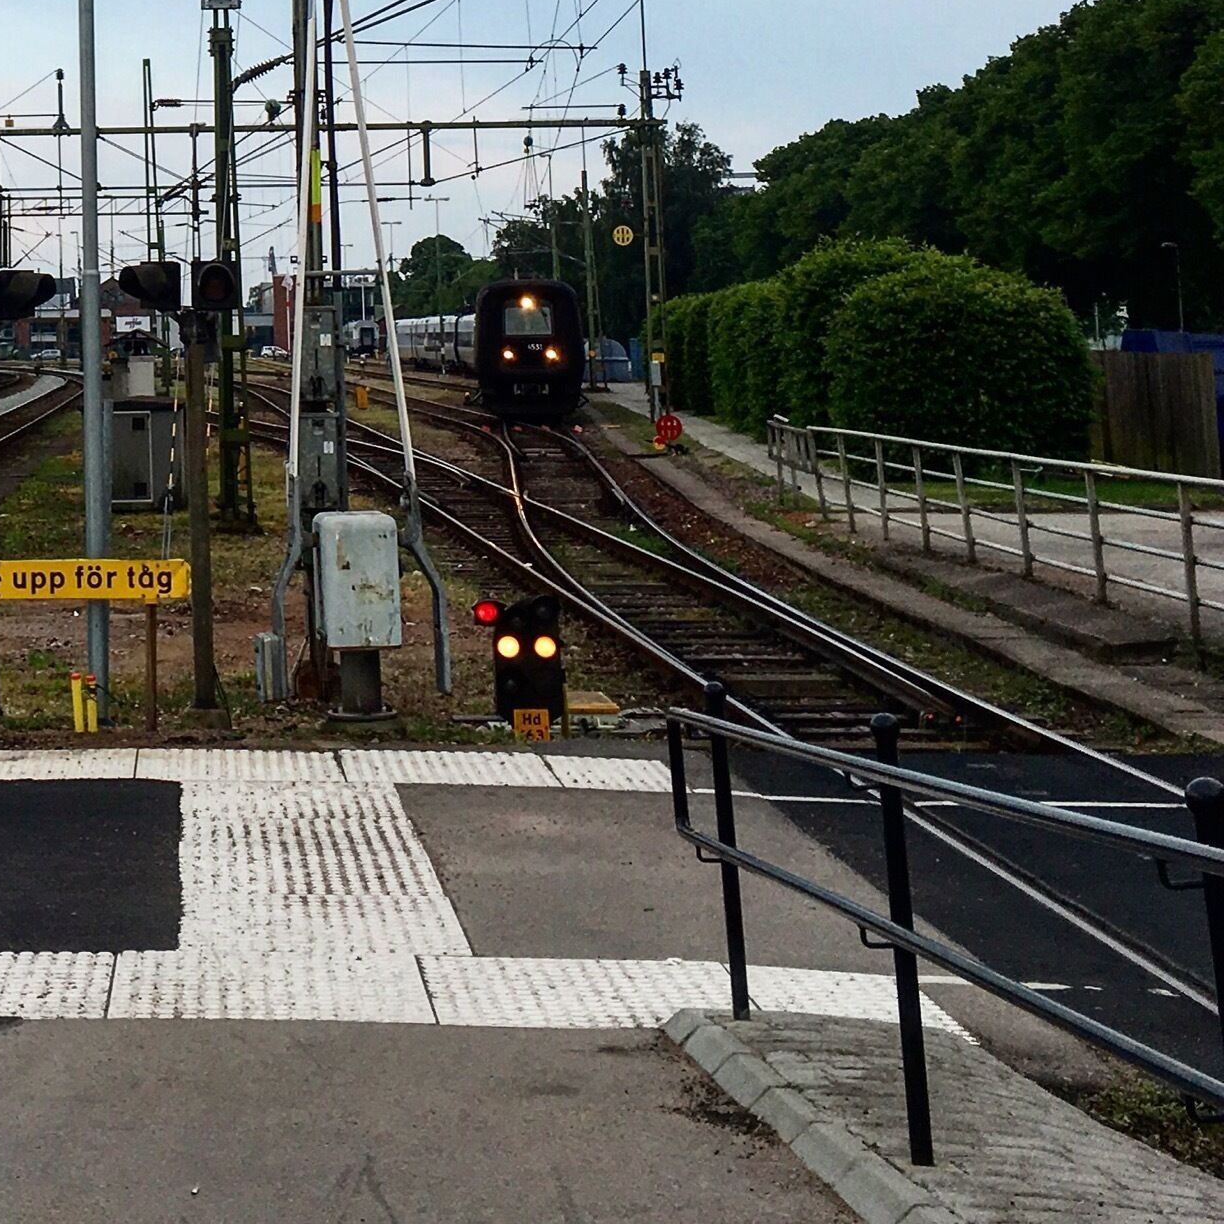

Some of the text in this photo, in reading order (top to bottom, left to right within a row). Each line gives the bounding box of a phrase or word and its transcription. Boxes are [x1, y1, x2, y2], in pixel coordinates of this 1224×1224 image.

[12, 571, 65, 595] upp
[75, 565, 118, 589] för
[128, 564, 173, 595] tåg
[522, 713, 541, 725] Hd
[521, 729, 544, 741] 63
